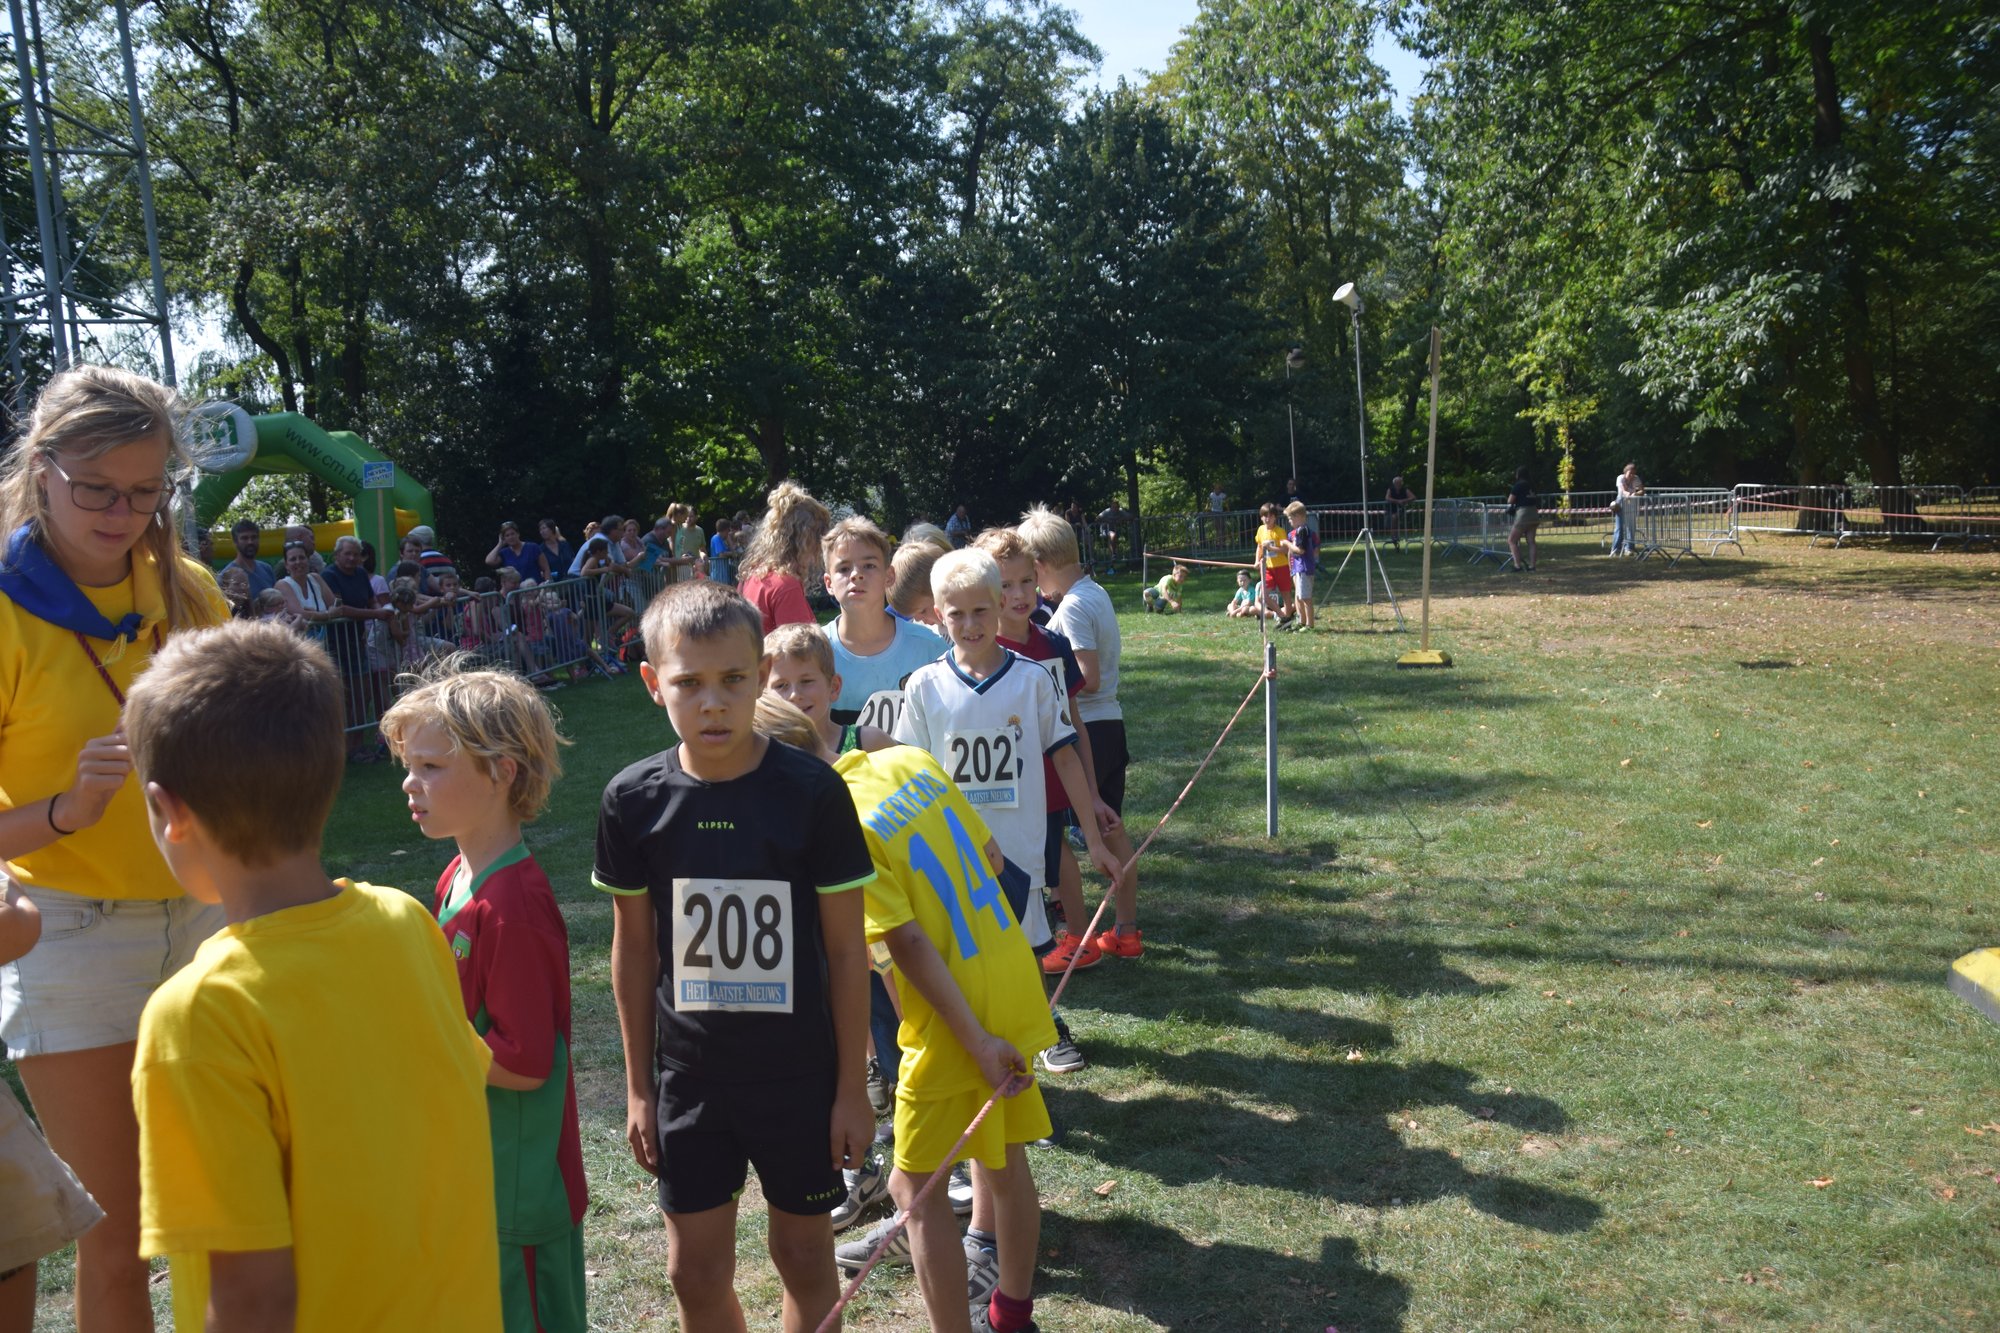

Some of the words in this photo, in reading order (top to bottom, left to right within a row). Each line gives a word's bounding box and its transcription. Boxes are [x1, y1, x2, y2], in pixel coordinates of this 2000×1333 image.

[286, 426, 364, 489] www.cm.be
[951, 735, 1013, 783] 202
[864, 769, 948, 842] MERTENS
[990, 789, 1012, 801] NIEUWS
[697, 821, 735, 829] KIPSTA
[908, 806, 1011, 960] 14
[683, 892, 783, 971] 208
[686, 982, 706, 1000] HET
[706, 982, 744, 1001] LAATSTE
[746, 984, 782, 1001] NIEUWS
